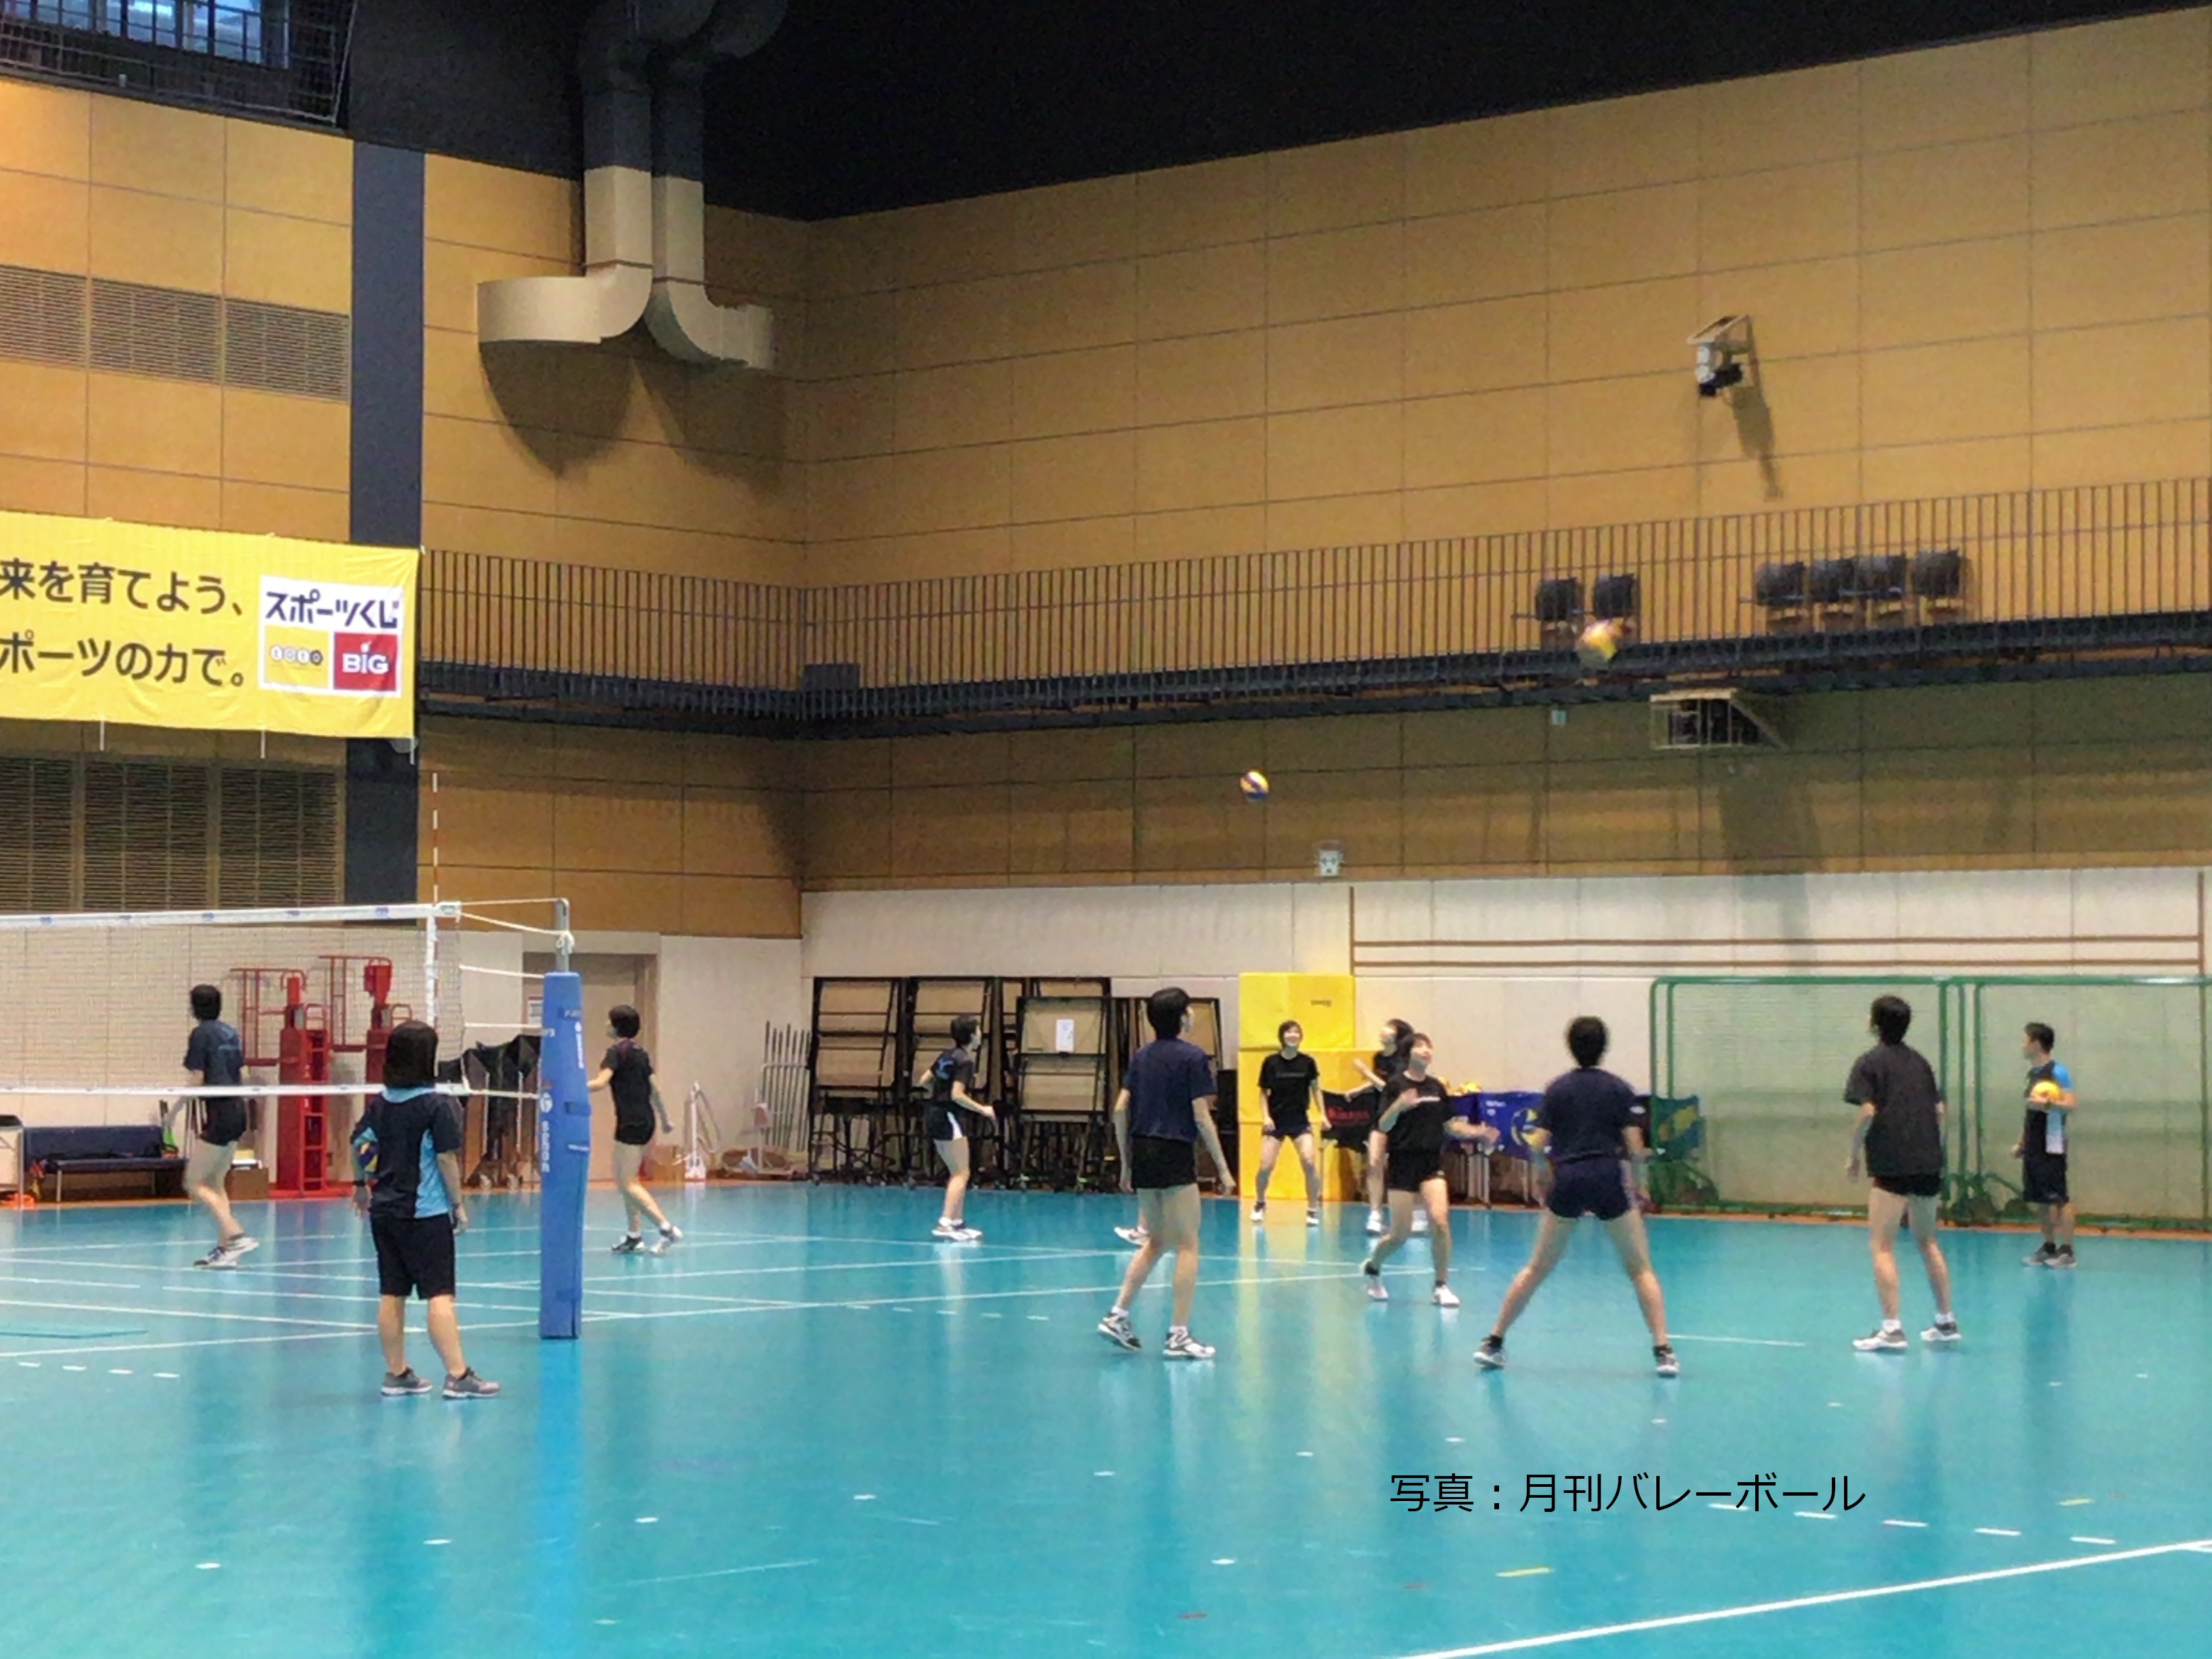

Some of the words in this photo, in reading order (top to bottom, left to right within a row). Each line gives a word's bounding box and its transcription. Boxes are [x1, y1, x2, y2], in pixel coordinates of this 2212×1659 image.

[265, 588, 399, 629] スポーツくじ
[270, 645, 323, 666] toto
